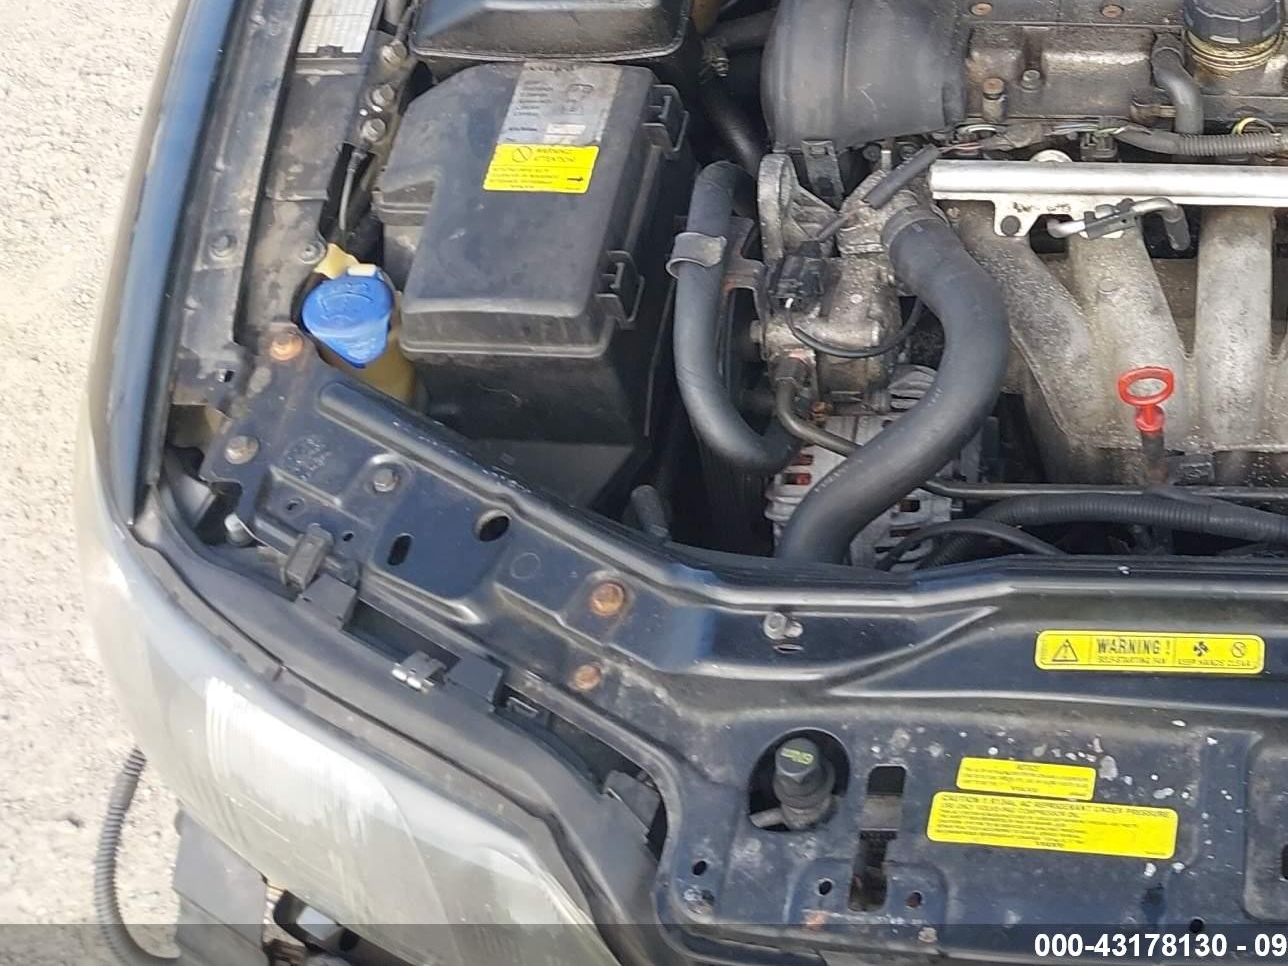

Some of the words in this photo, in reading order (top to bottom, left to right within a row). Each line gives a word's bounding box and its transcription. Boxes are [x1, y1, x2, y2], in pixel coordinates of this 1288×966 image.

[1097, 638, 1160, 654] WARNING
[943, 795, 979, 804] CAUTION
[1126, 808, 1170, 818] PRESSURE
